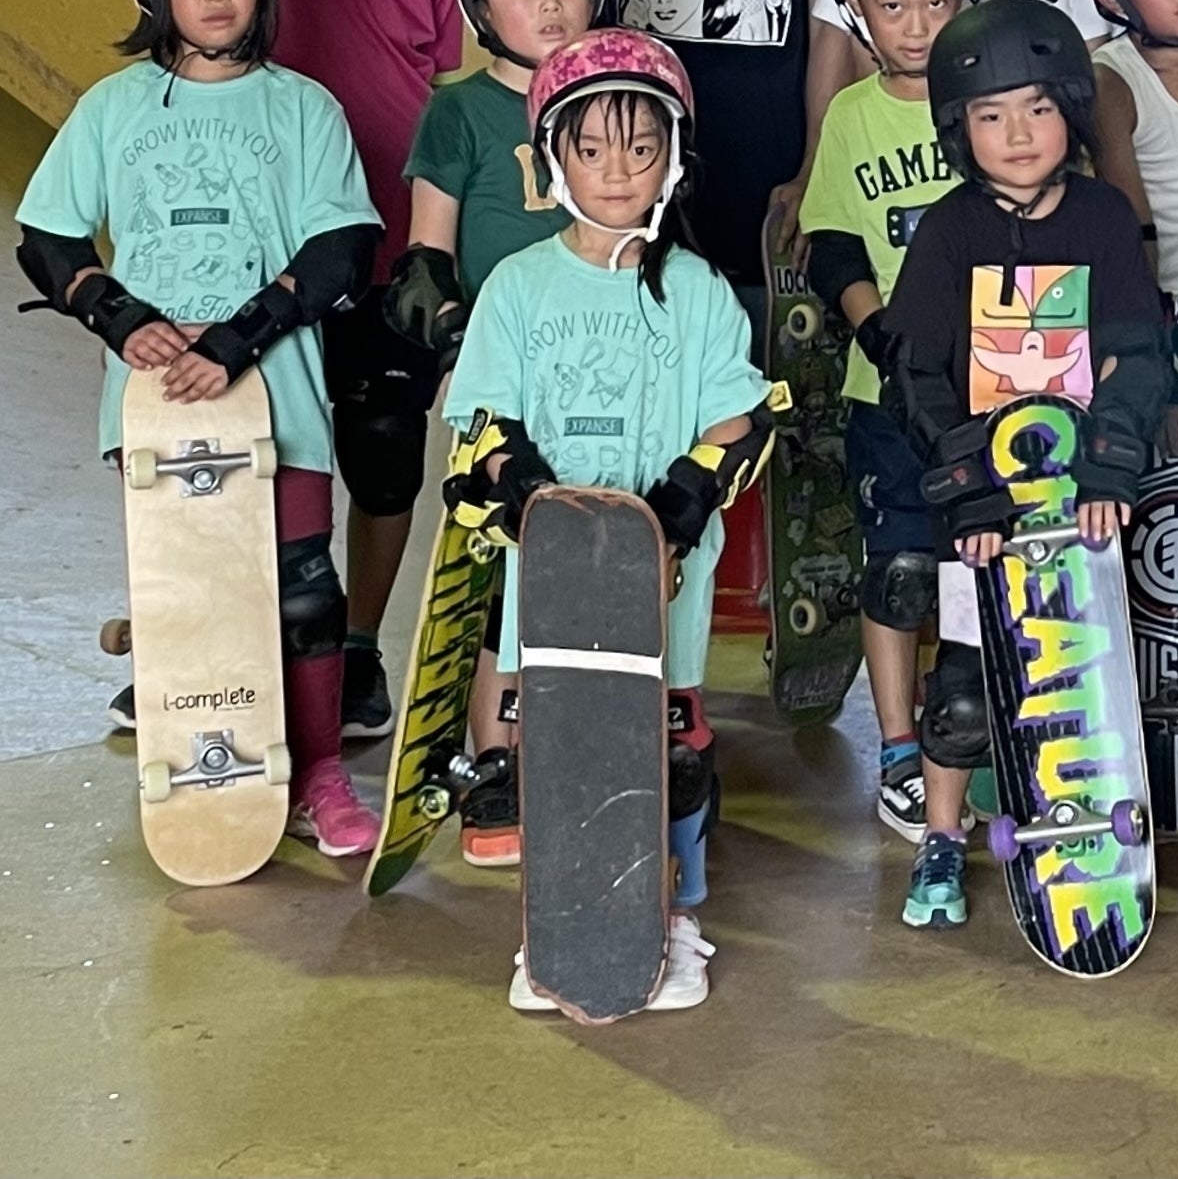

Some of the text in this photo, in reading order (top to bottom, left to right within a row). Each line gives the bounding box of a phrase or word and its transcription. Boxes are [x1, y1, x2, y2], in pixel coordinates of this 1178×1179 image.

[122, 118, 281, 167] GROW WITH YOU
[582, 311, 641, 343] WITH
